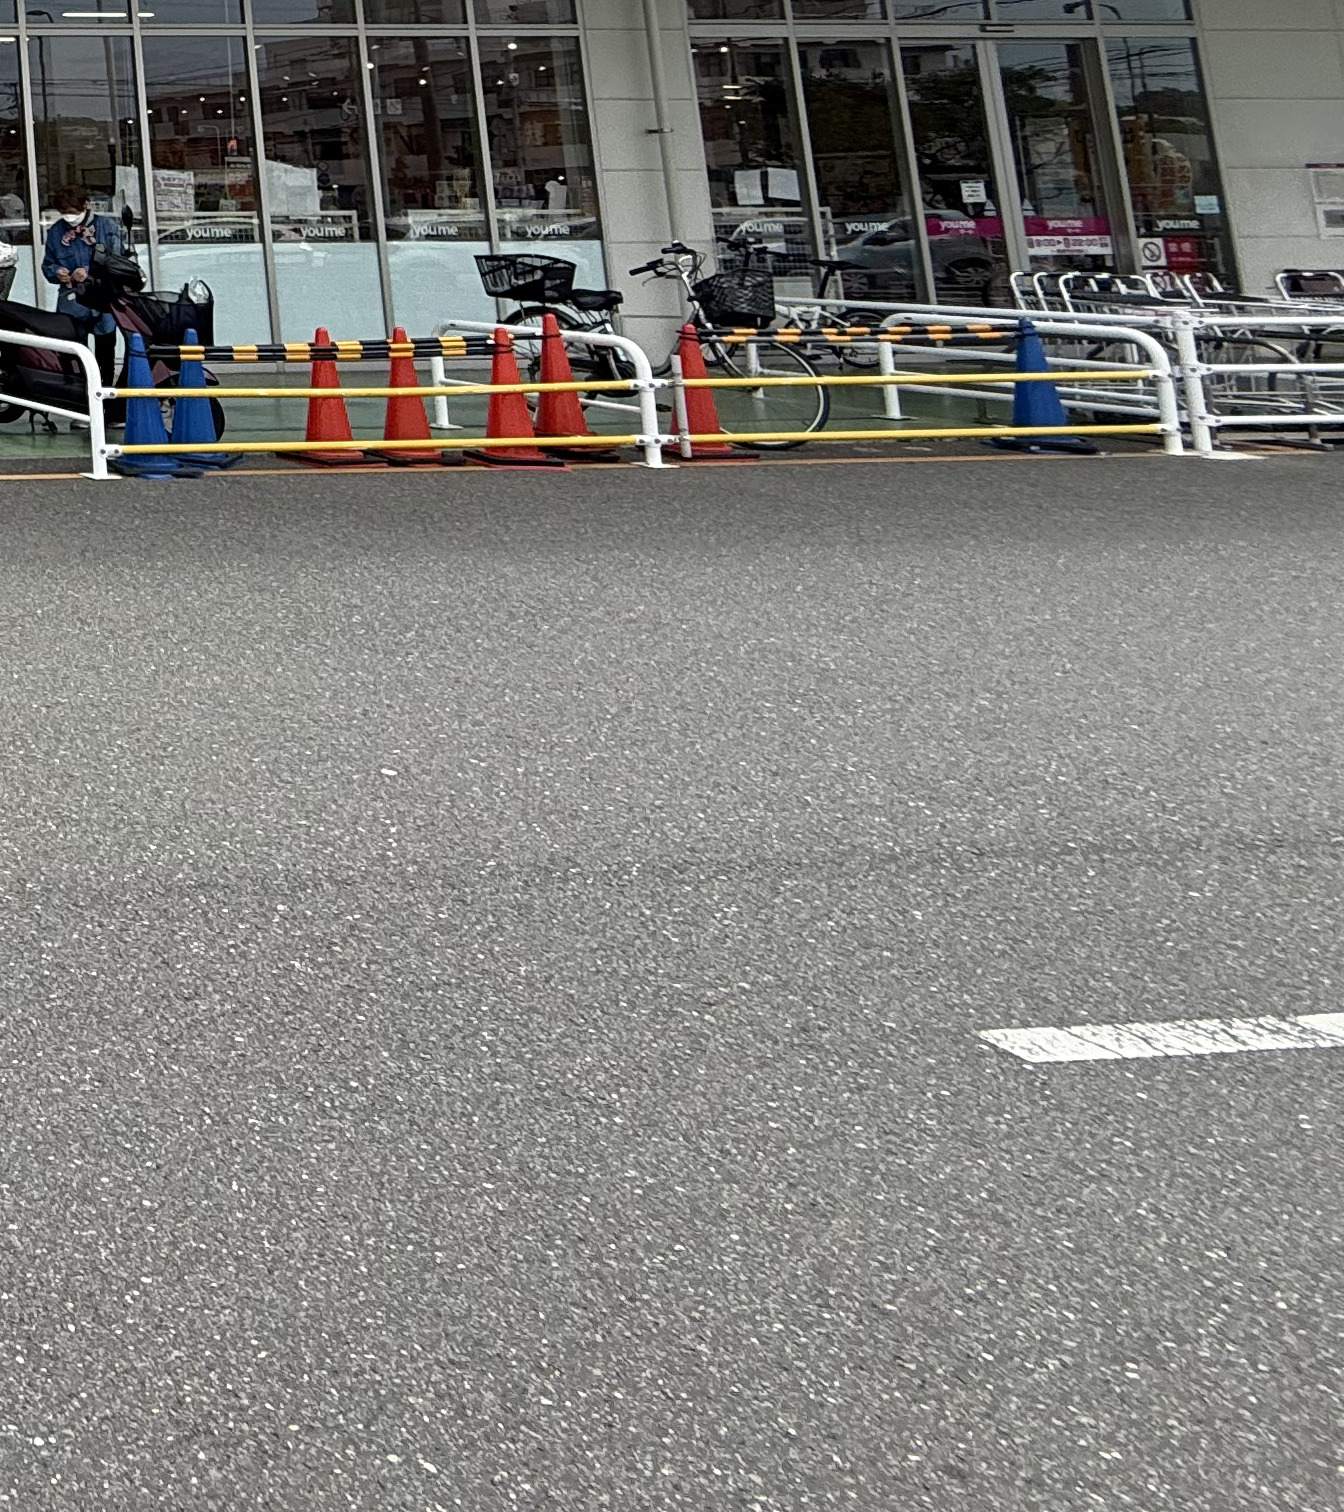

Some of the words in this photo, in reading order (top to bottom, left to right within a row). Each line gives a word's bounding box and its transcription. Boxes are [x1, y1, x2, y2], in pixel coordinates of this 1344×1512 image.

[412, 224, 459, 238] youme
[525, 223, 570, 237] youme
[740, 222, 784, 235] youme
[845, 221, 889, 234] youme
[1155, 218, 1201, 231] youme
[186, 227, 232, 241] youme
[300, 226, 346, 239] youme
